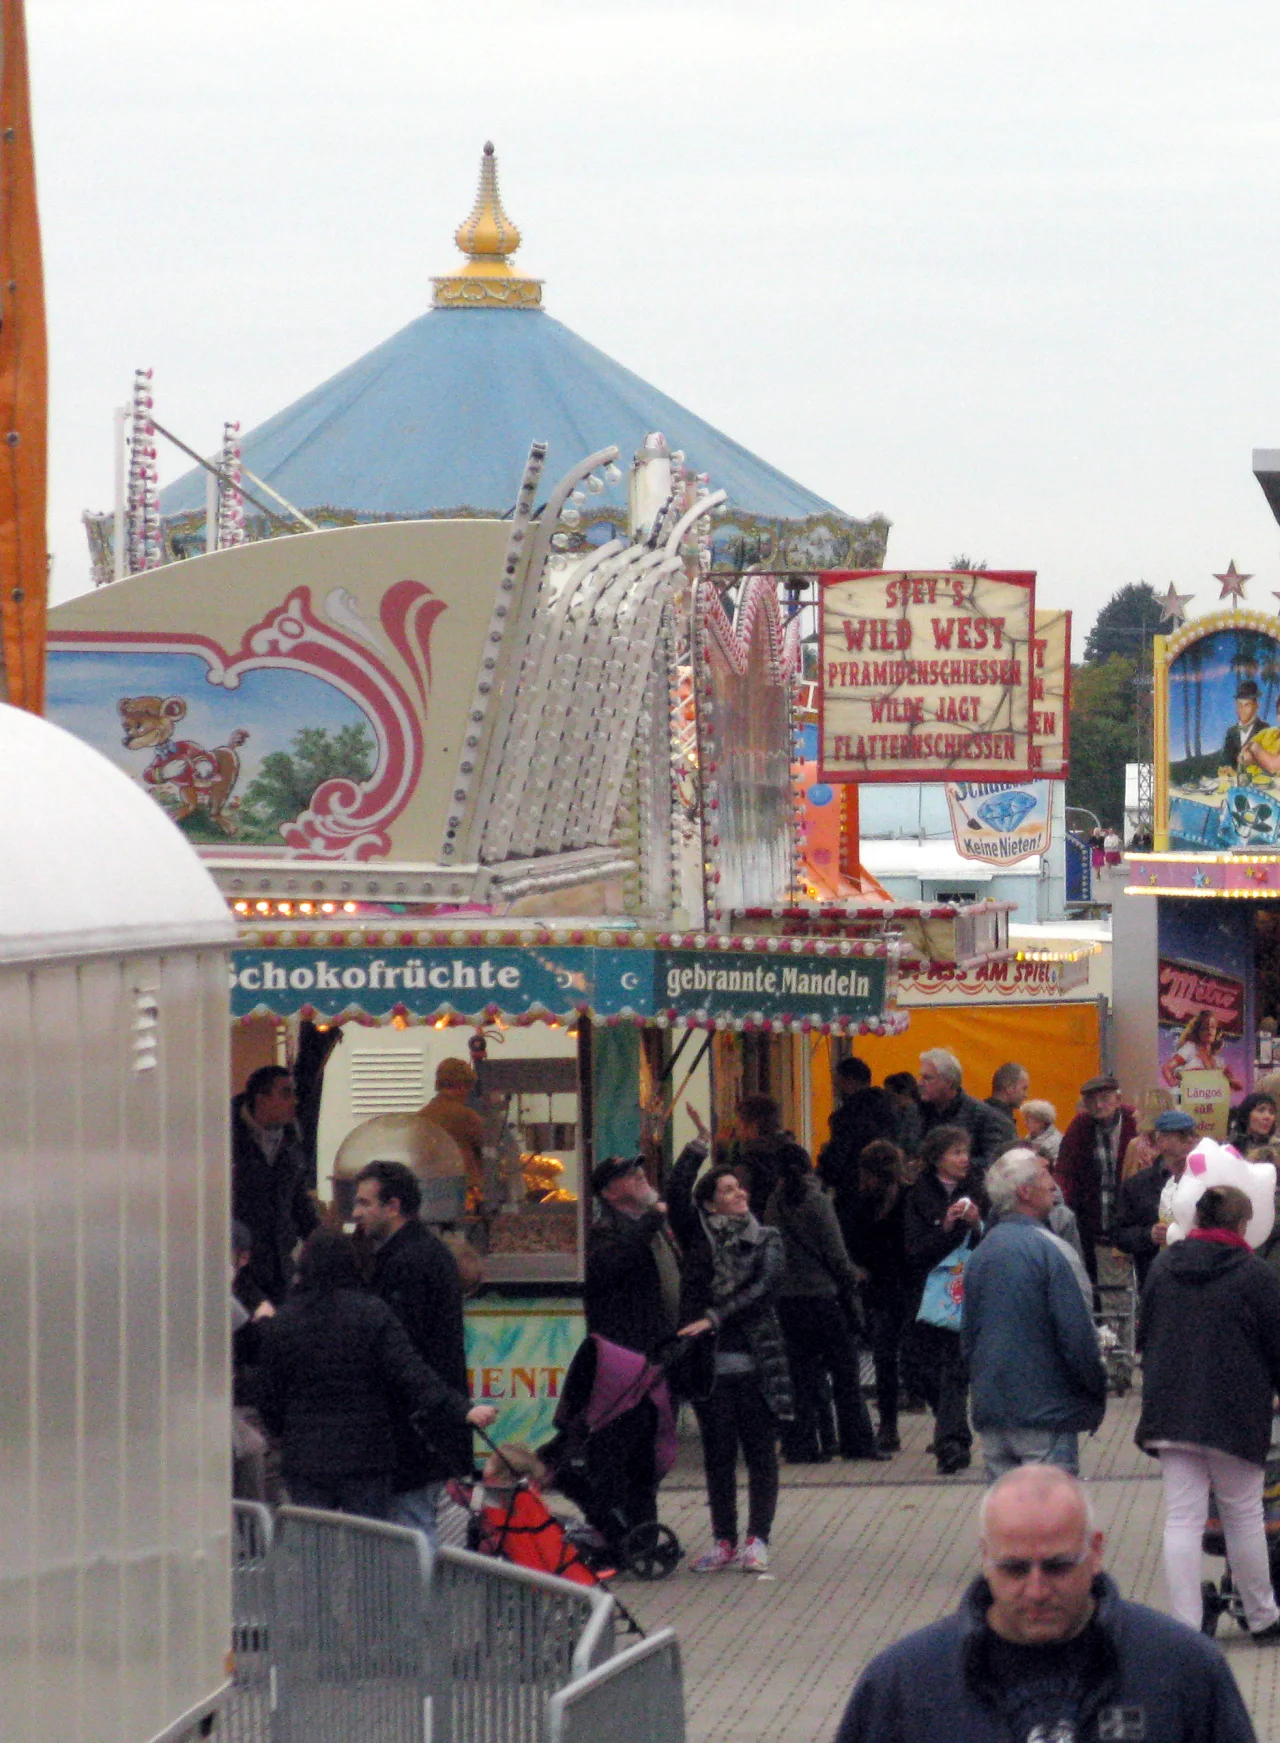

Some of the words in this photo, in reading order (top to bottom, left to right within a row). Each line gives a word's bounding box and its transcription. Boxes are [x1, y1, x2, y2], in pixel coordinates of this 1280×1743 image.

[843, 617, 913, 650] WILD
[931, 617, 1006, 650] WEST
[828, 659, 1021, 688] PYRAMIDENSCHIESSEN
[870, 696, 924, 723] WILDE
[936, 695, 982, 723] JAGT
[964, 838, 999, 857] Keine
[1000, 833, 1042, 858] Nieten!
[667, 962, 777, 997] gebrannte
[781, 967, 870, 997] Mandeln
[975, 963, 1009, 982] AM
[1013, 961, 1051, 983] SPIEL
[467, 1367, 566, 1399] ENT
